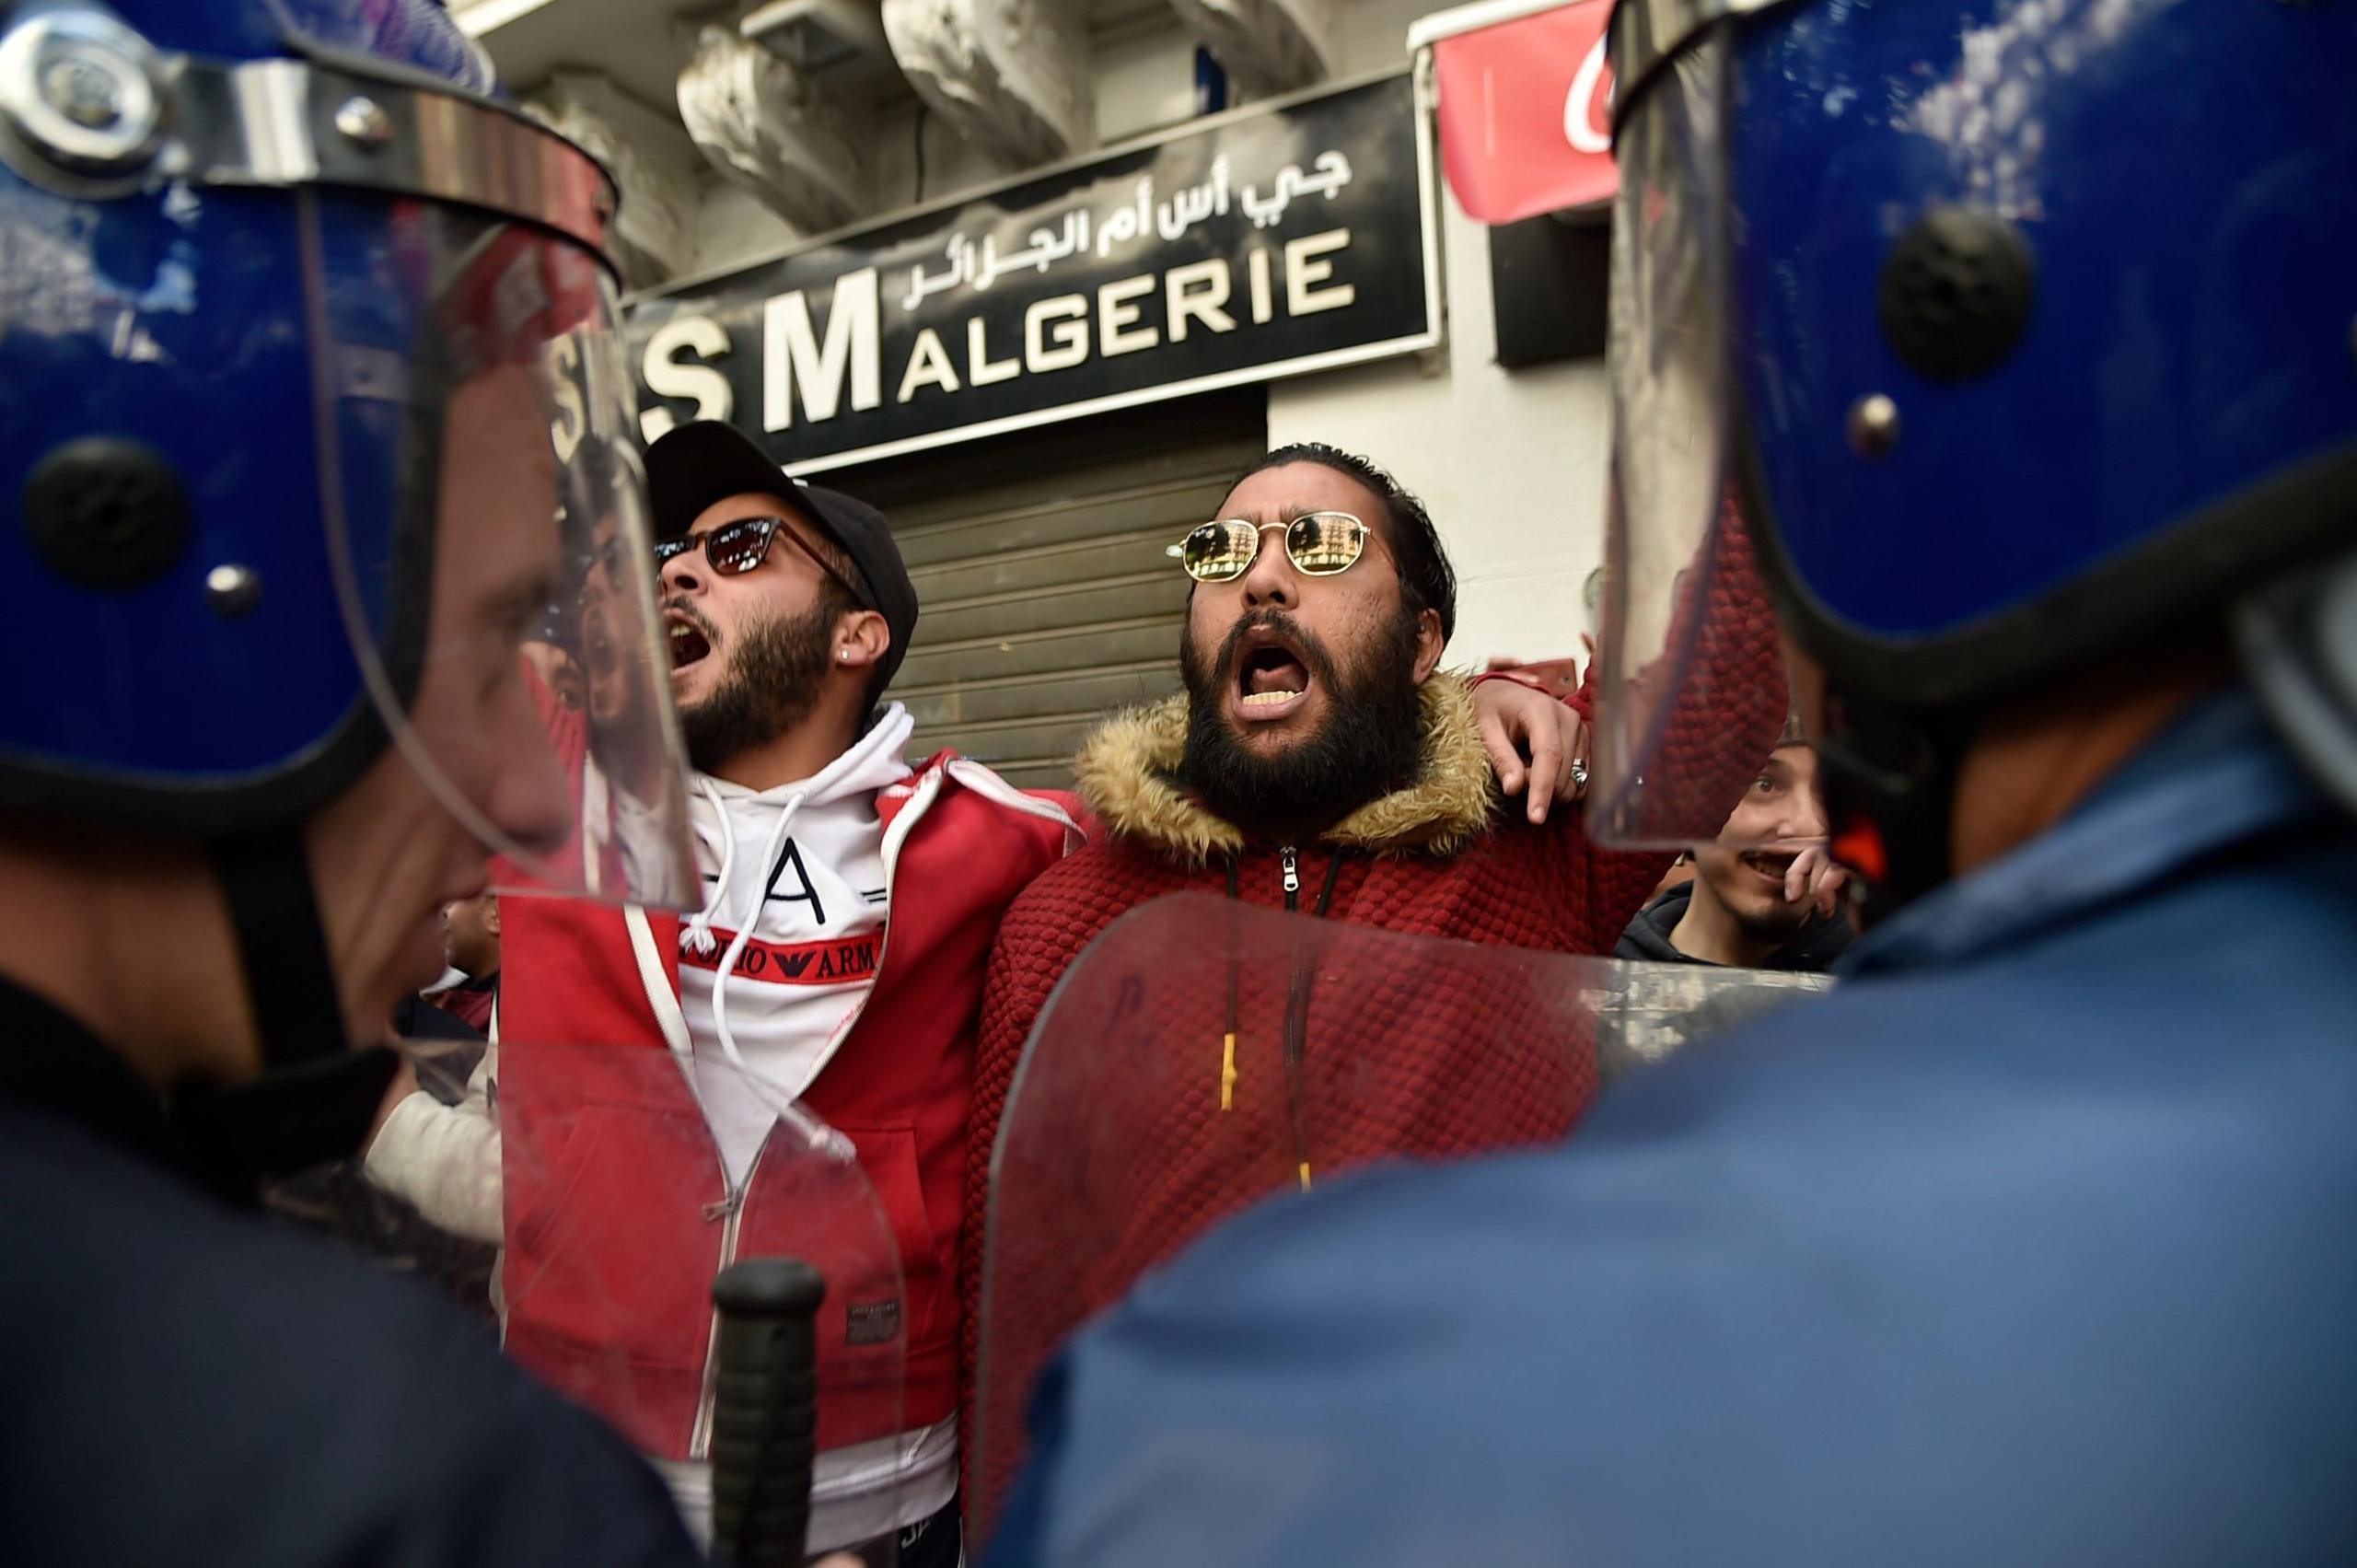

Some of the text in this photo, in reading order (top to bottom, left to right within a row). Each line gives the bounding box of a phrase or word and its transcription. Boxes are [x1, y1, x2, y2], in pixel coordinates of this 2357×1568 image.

[1097, 174, 1155, 259] أم
[1157, 152, 1230, 241] أس
[1241, 150, 1353, 228] جي
[896, 227, 1356, 404] ALGERIE
[752, 835, 827, 934] A
